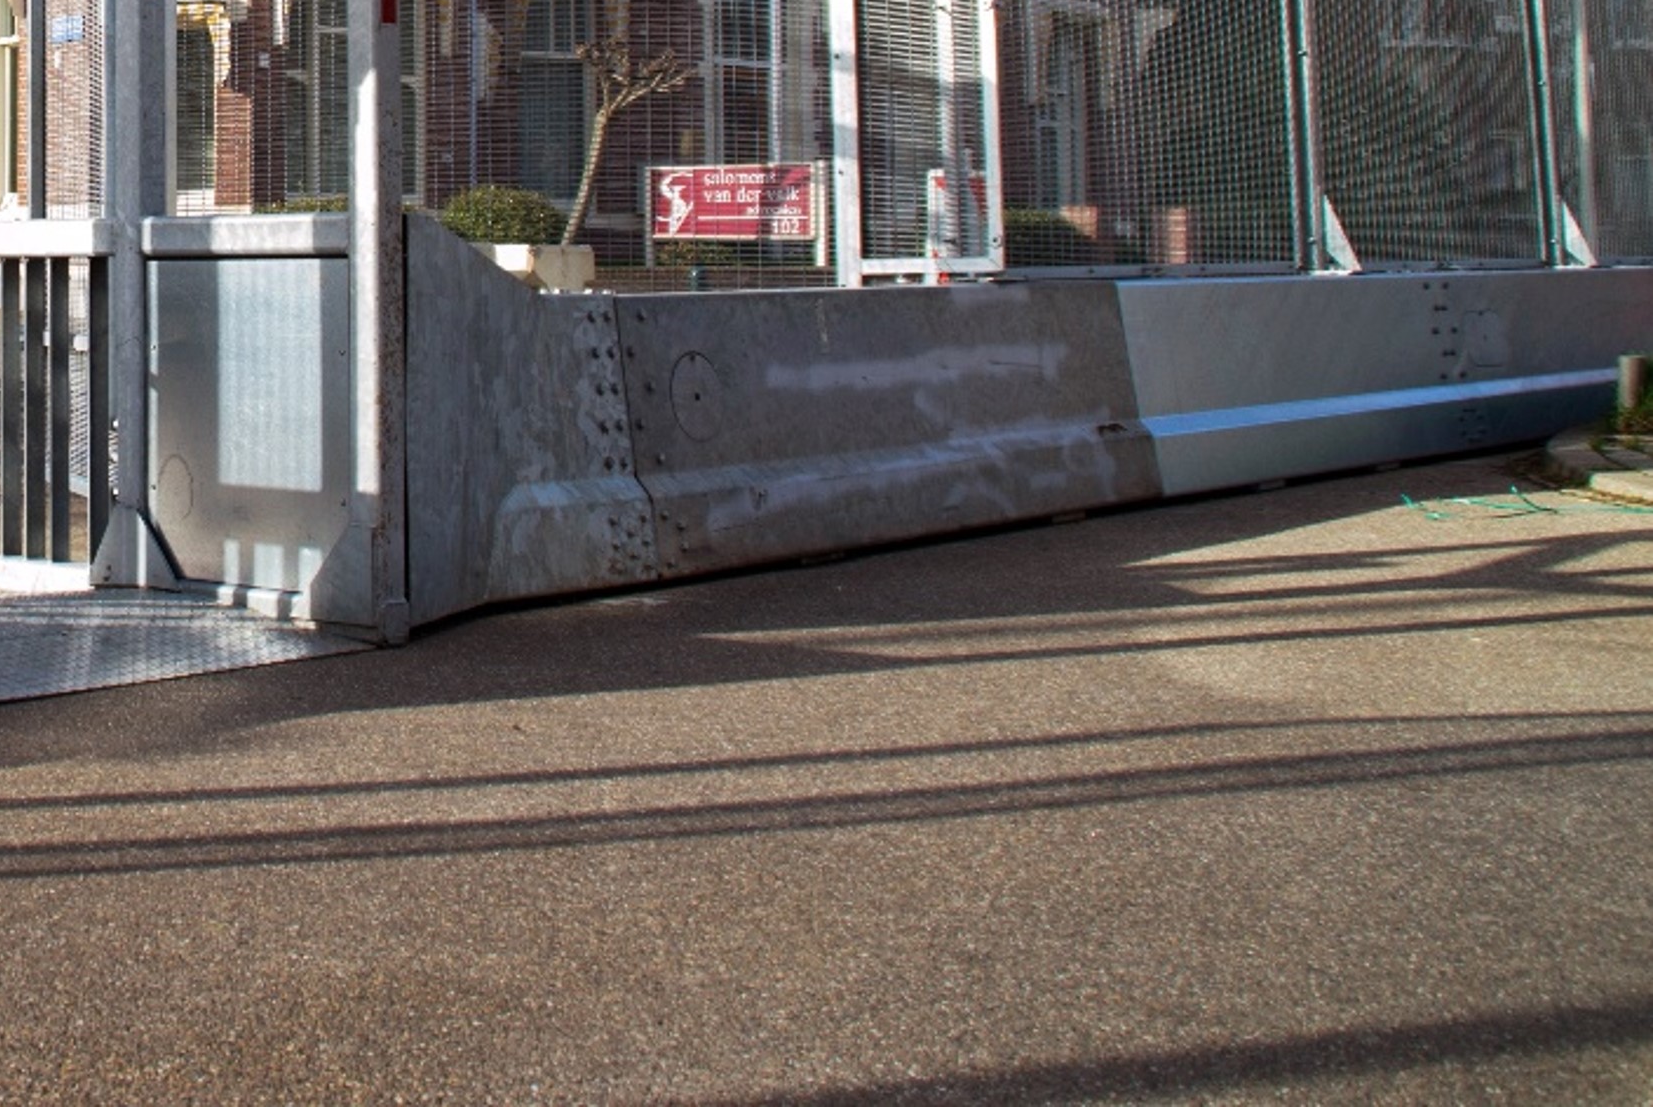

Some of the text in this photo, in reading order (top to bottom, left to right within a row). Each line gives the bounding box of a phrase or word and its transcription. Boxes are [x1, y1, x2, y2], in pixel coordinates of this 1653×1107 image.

[703, 189, 732, 203] van
[737, 186, 761, 203] der
[772, 220, 800, 234] 102
